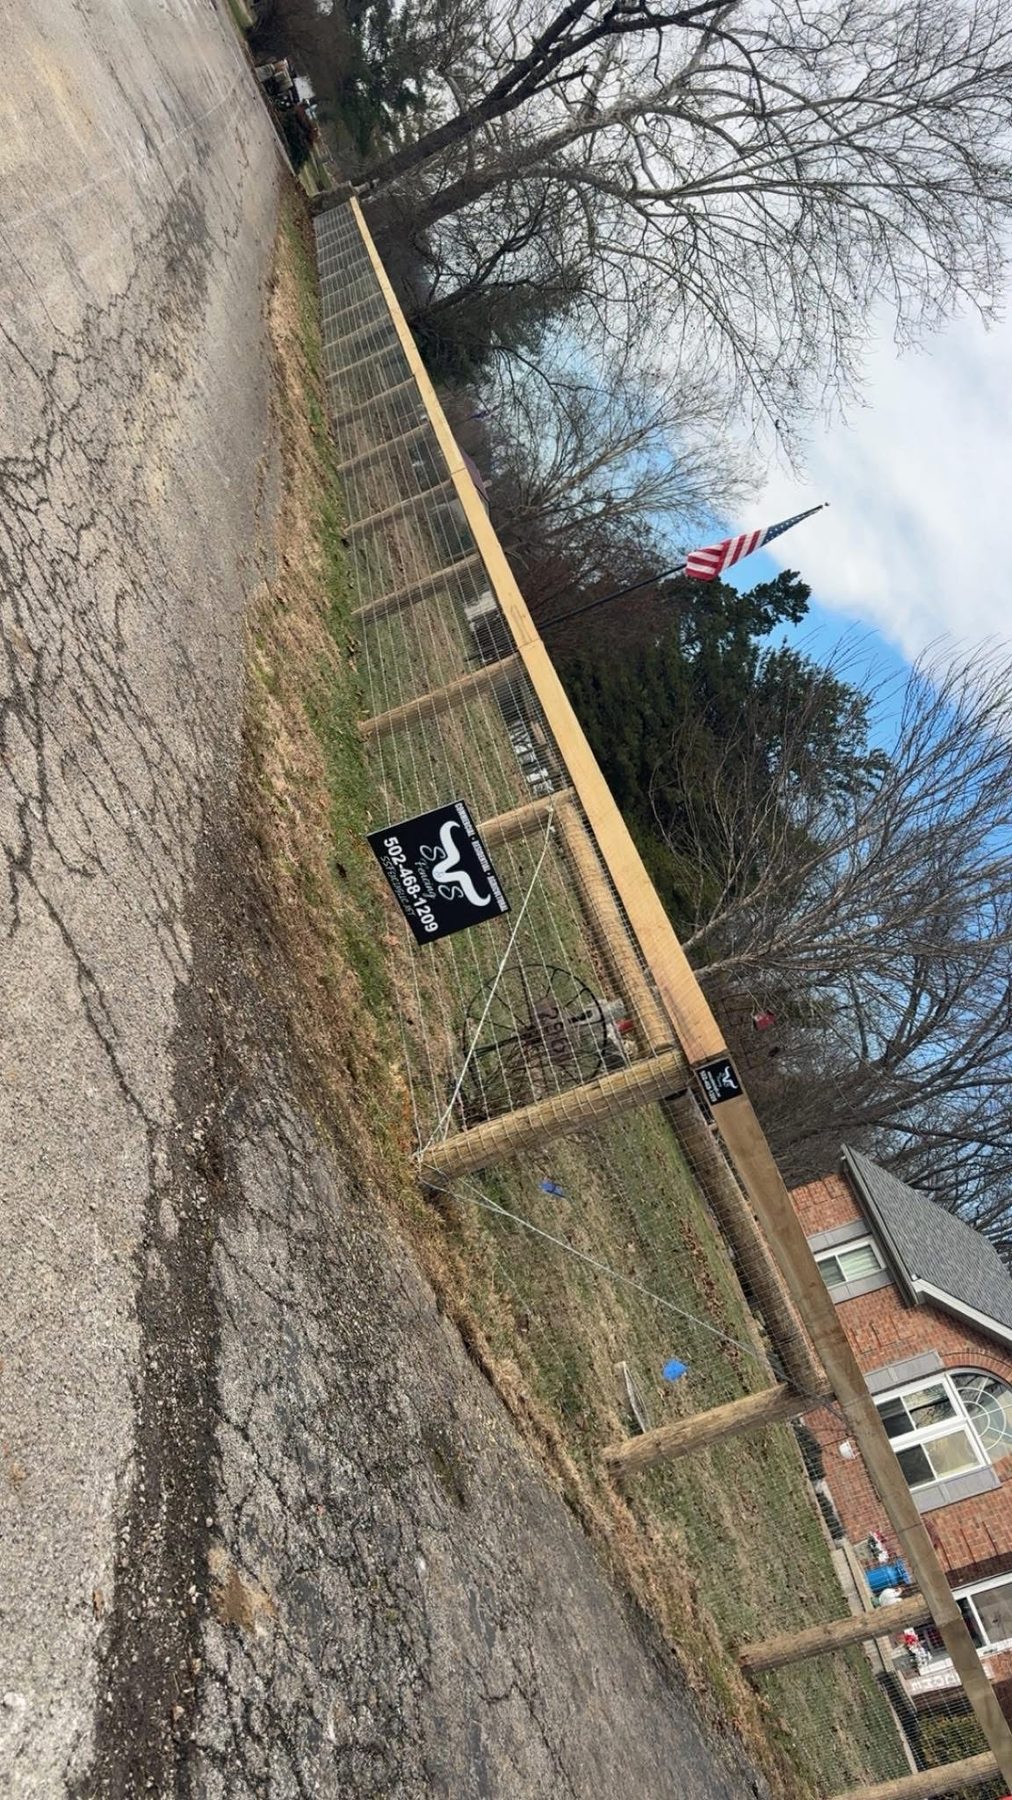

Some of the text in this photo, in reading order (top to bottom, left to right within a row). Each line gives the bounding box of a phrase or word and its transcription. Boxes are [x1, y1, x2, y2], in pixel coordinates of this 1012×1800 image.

[471, 840, 491, 872] RESIDENTIAL
[383, 836, 439, 933] 502-468-1209
[415, 858, 437, 899] Fencing
